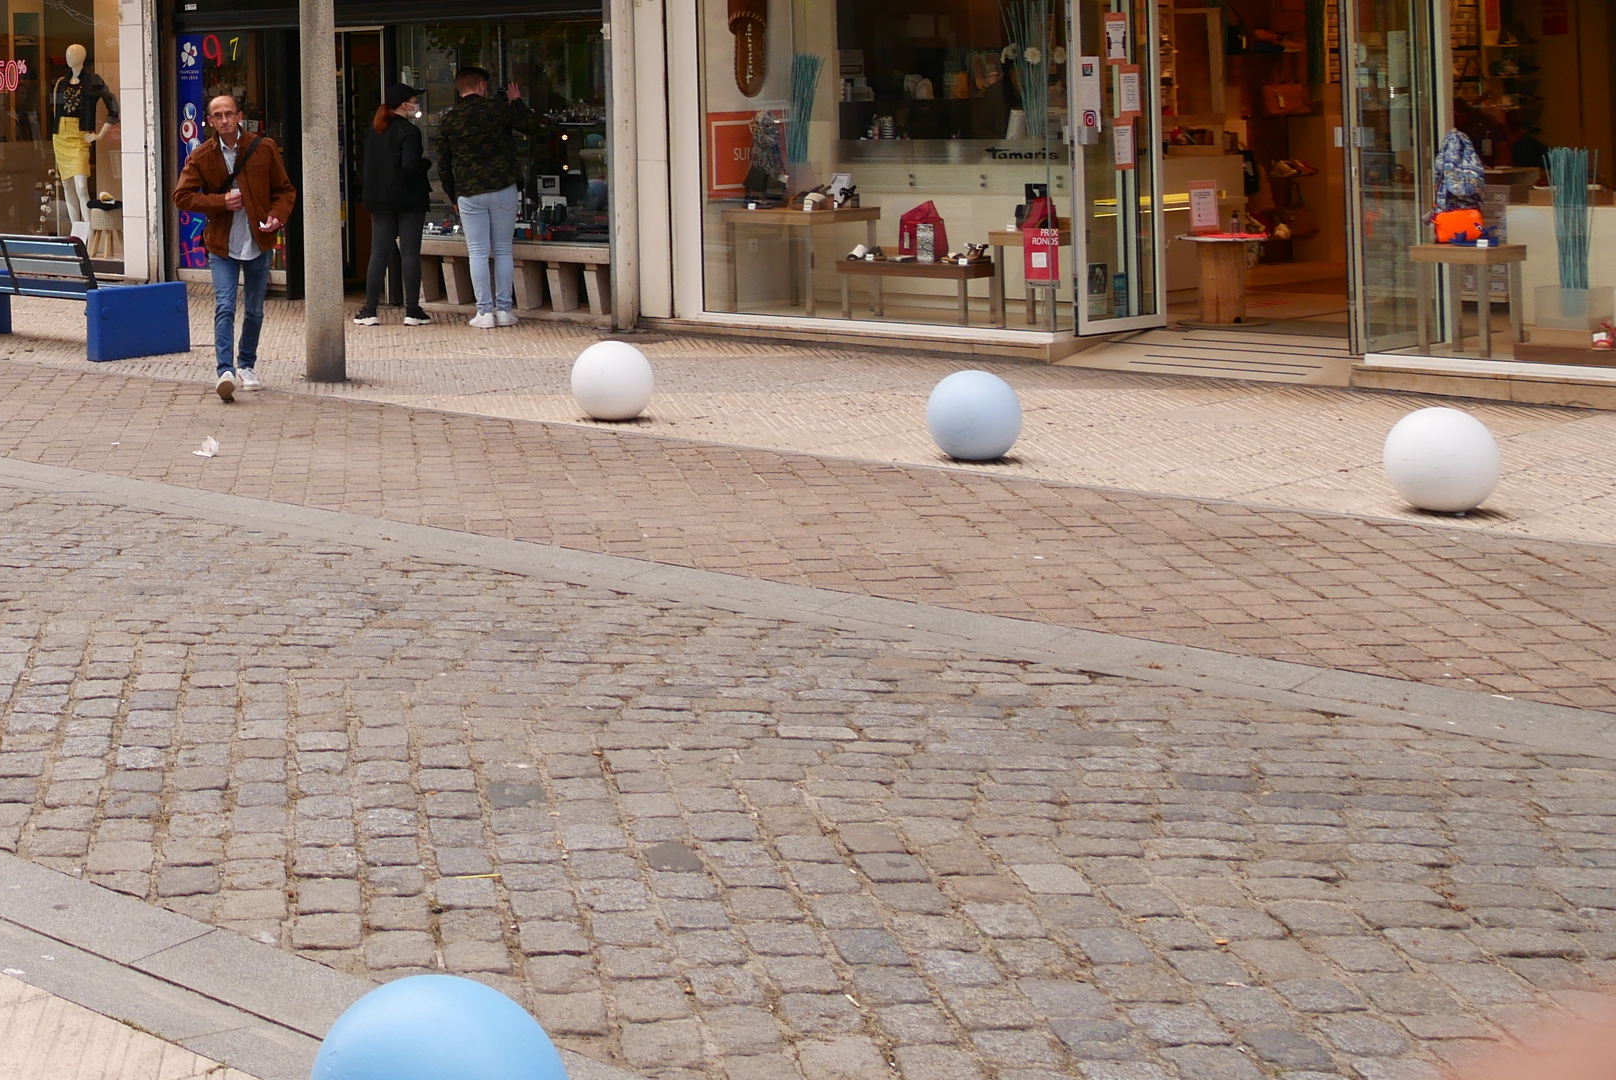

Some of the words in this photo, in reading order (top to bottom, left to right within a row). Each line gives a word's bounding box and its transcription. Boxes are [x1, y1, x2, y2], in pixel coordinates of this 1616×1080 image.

[202, 33, 223, 67] 9
[984, 146, 1059, 160] Tamaris
[1040, 228, 1059, 237] PRIX
